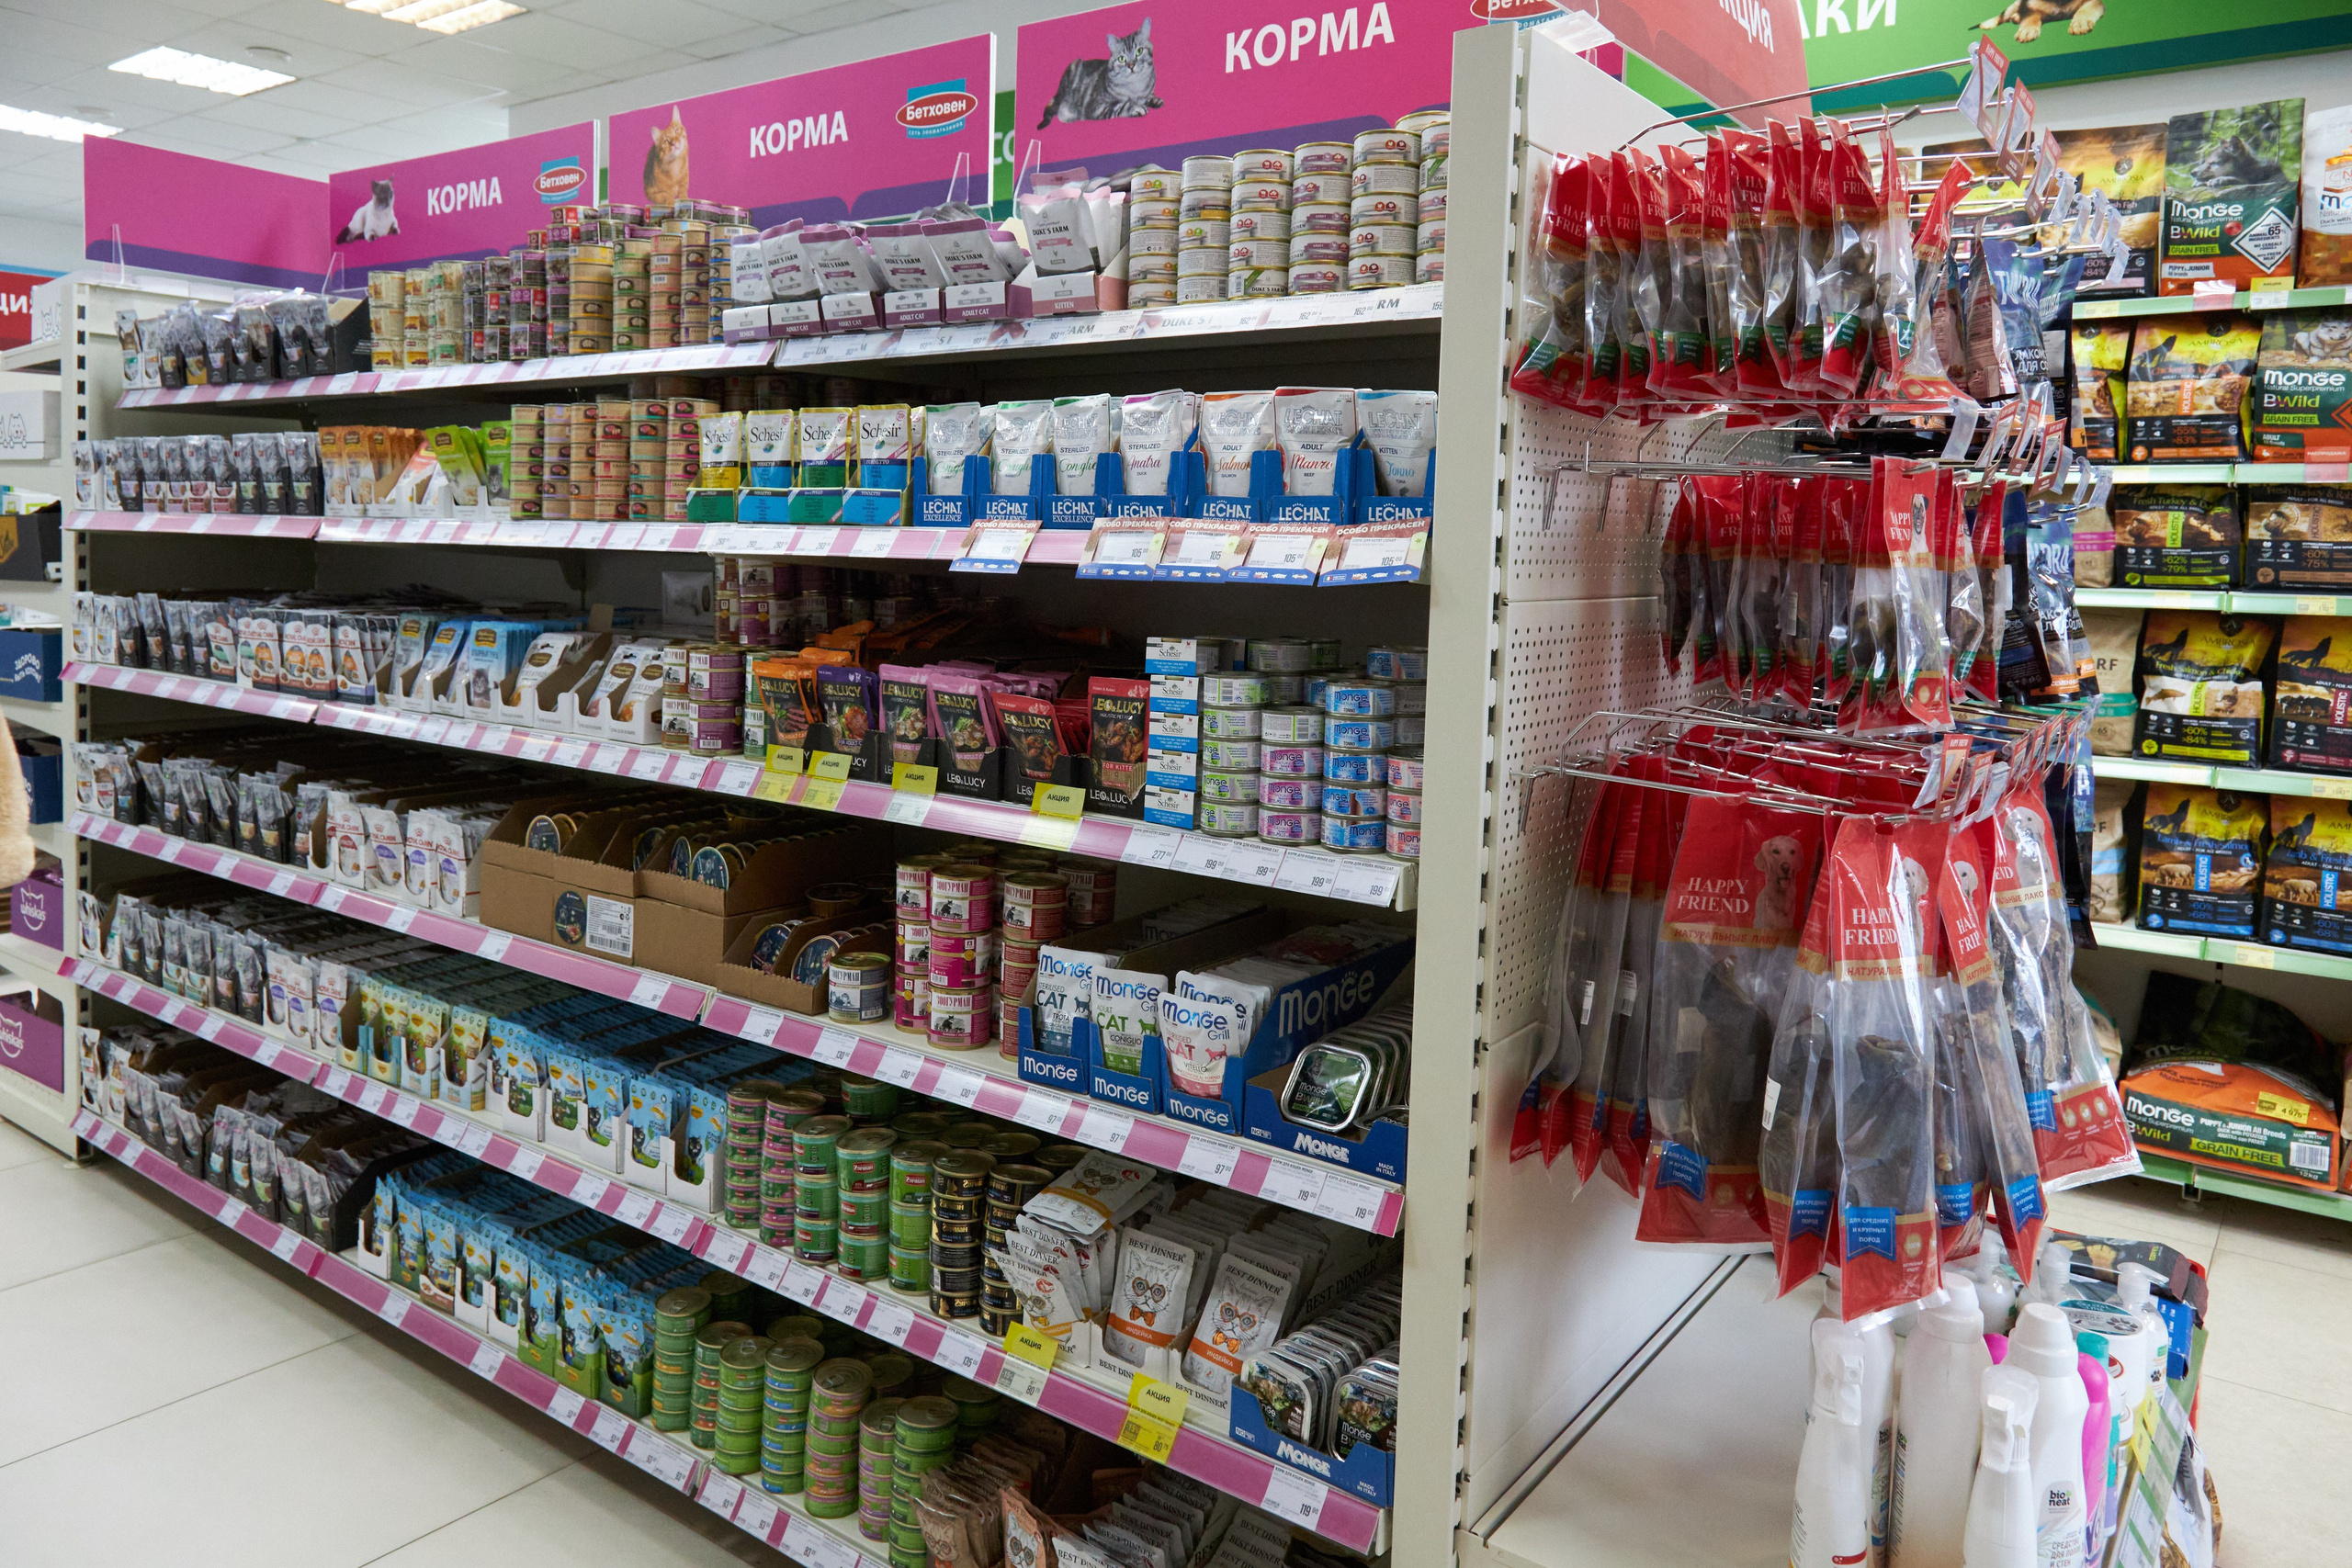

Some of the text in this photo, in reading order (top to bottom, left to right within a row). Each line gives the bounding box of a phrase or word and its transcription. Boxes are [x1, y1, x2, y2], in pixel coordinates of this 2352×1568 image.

[1225, 2, 1395, 73] КОРМА
[907, 98, 966, 120] Бетховен
[750, 110, 848, 159] КОРМА
[540, 173, 579, 189] Бетховен
[427, 176, 503, 216] КОРМА
[2193, 216, 2243, 224] Superpremium
[962, 308, 989, 317] ADULT CAT
[1054, 301, 1074, 310] KITTEN
[1354, 307, 1366, 315] 162
[899, 312, 924, 321] ADULT CAT
[2182, 382, 2193, 413] HOLISTIC
[750, 427, 786, 444] Schesir
[861, 423, 901, 439] Schesir
[923, 502, 962, 514] LECHAT
[987, 501, 1027, 514] LECHAT
[1052, 502, 1095, 514] LECHAT
[1203, 502, 1250, 519] LECHAT
[1279, 506, 1330, 521] LECHAT
[1336, 521, 1424, 535] ОСОБО ПРЕКРАСЕН
[2170, 513, 2180, 546] HOLISTIC
[1283, 554, 1295, 562] 105
[1382, 557, 1394, 565] 105
[1162, 687, 1183, 696] Schesir
[2335, 692, 2347, 724] HOLISTIC
[1162, 725, 1183, 734] Schesir
[905, 773, 924, 781] АКЦИЯ
[1047, 794, 1069, 802] АКЦИЯ
[1204, 859, 1217, 869] 199
[1256, 865, 1268, 876] 199
[2199, 856, 2208, 889] HOLISTIC
[1370, 886, 1384, 896] 199
[1688, 877, 1749, 894] HAPPY
[2324, 873, 2335, 907] HOLISTIC
[1677, 896, 1749, 913] FRIEND
[1036, 991, 1067, 1010] CAT
[1097, 1012, 1128, 1032] CAT
[1207, 1029, 1229, 1040] Grill
[1167, 1037, 1195, 1061] CAT
[2200, 1118, 2222, 1128] PUPPY
[2227, 1122, 2252, 1132] JUNIOR
[2263, 1128, 2286, 1140] Breeds
[1294, 1132, 1349, 1163] MONGE
[2197, 1141, 2278, 1165] GRAIN FREE
[1215, 1165, 1225, 1174] 97
[1383, 1168, 1396, 1177] ITALY
[1297, 1190, 1309, 1201] 119
[1011, 1241, 1029, 1253] BEST
[1128, 1238, 1186, 1263] BEST DINNER
[1226, 1265, 1283, 1294] BEST DINNER
[1125, 1325, 1152, 1339] ИНДЕЙКА
[1020, 1337, 1042, 1349] АКЦИЯ
[1206, 1349, 1233, 1367] ИНДЕЙКА
[1146, 1389, 1170, 1403] АКЦИЯ
[1175, 1382, 1227, 1409] BEST DINNER
[1276, 1440, 1330, 1477] MONGE
[1360, 1481, 1374, 1490] MADE
[1364, 1487, 1376, 1496] ITALY
[2049, 1497, 2070, 1506] neat
[2050, 1490, 2065, 1499] bio
[1300, 1504, 1311, 1517] 119
